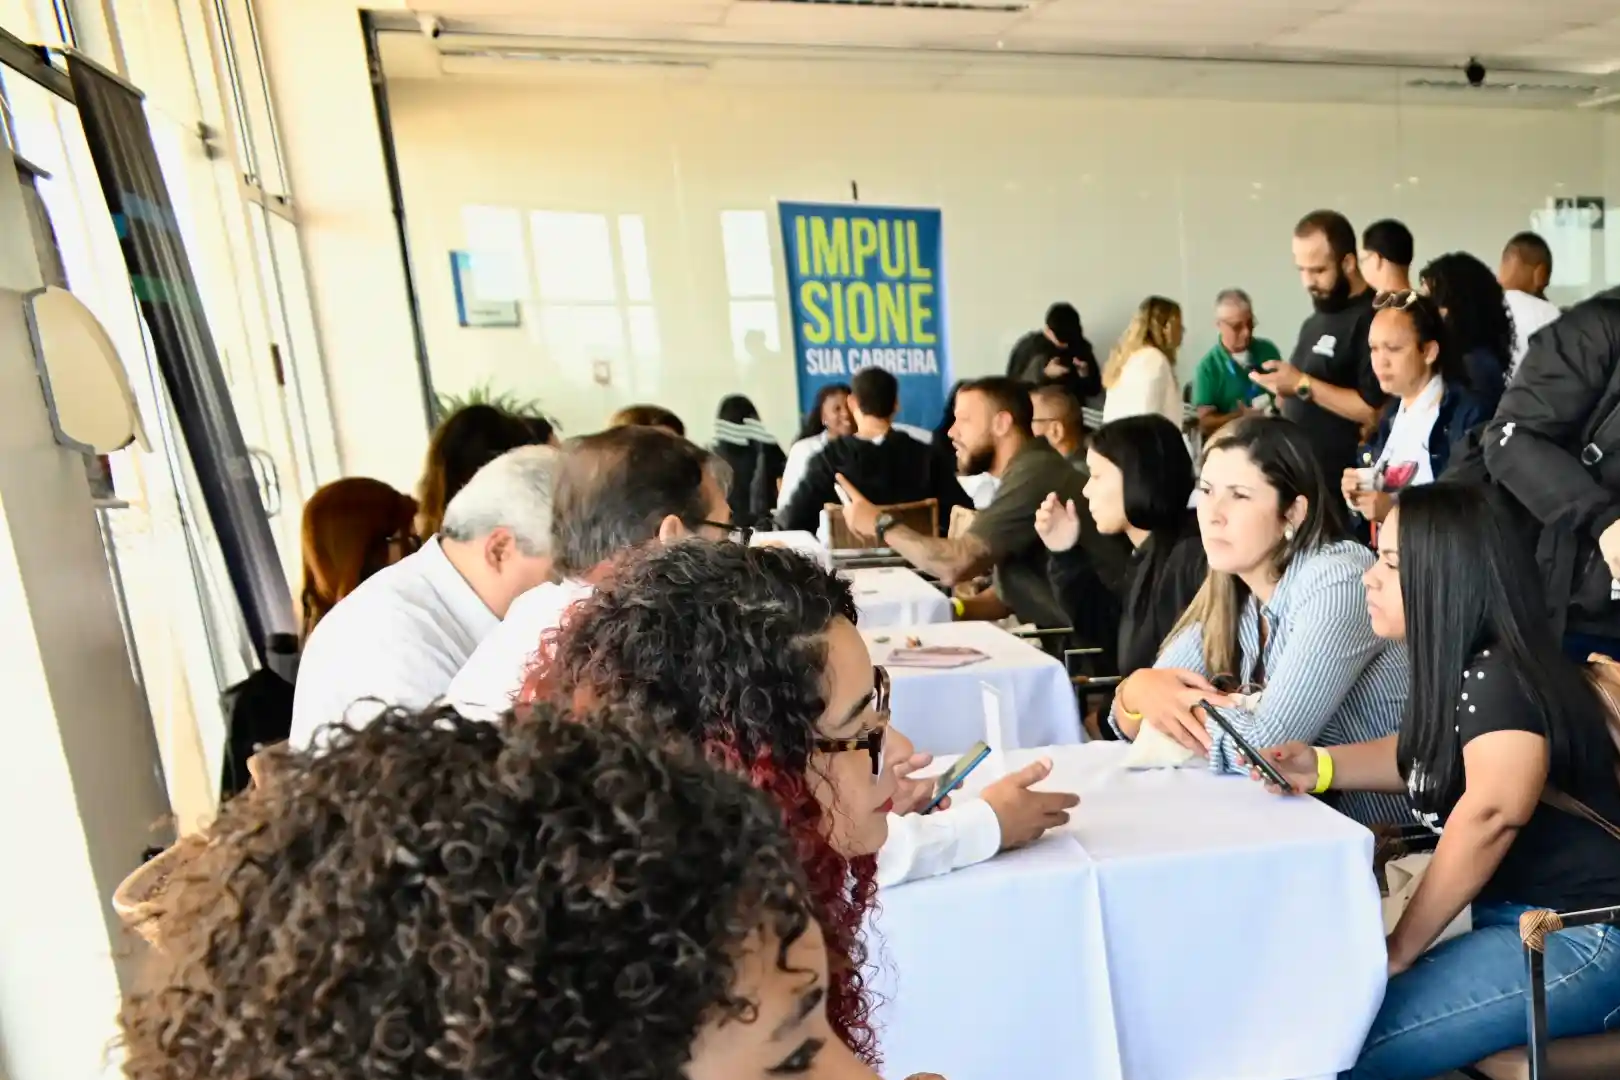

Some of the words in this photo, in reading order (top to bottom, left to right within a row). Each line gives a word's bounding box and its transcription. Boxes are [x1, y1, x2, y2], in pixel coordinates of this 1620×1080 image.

[795, 215, 932, 279] IMPUL
[800, 280, 937, 344] SIONE
[805, 348, 846, 376] SUA
[848, 348, 938, 375] CARREIRA
